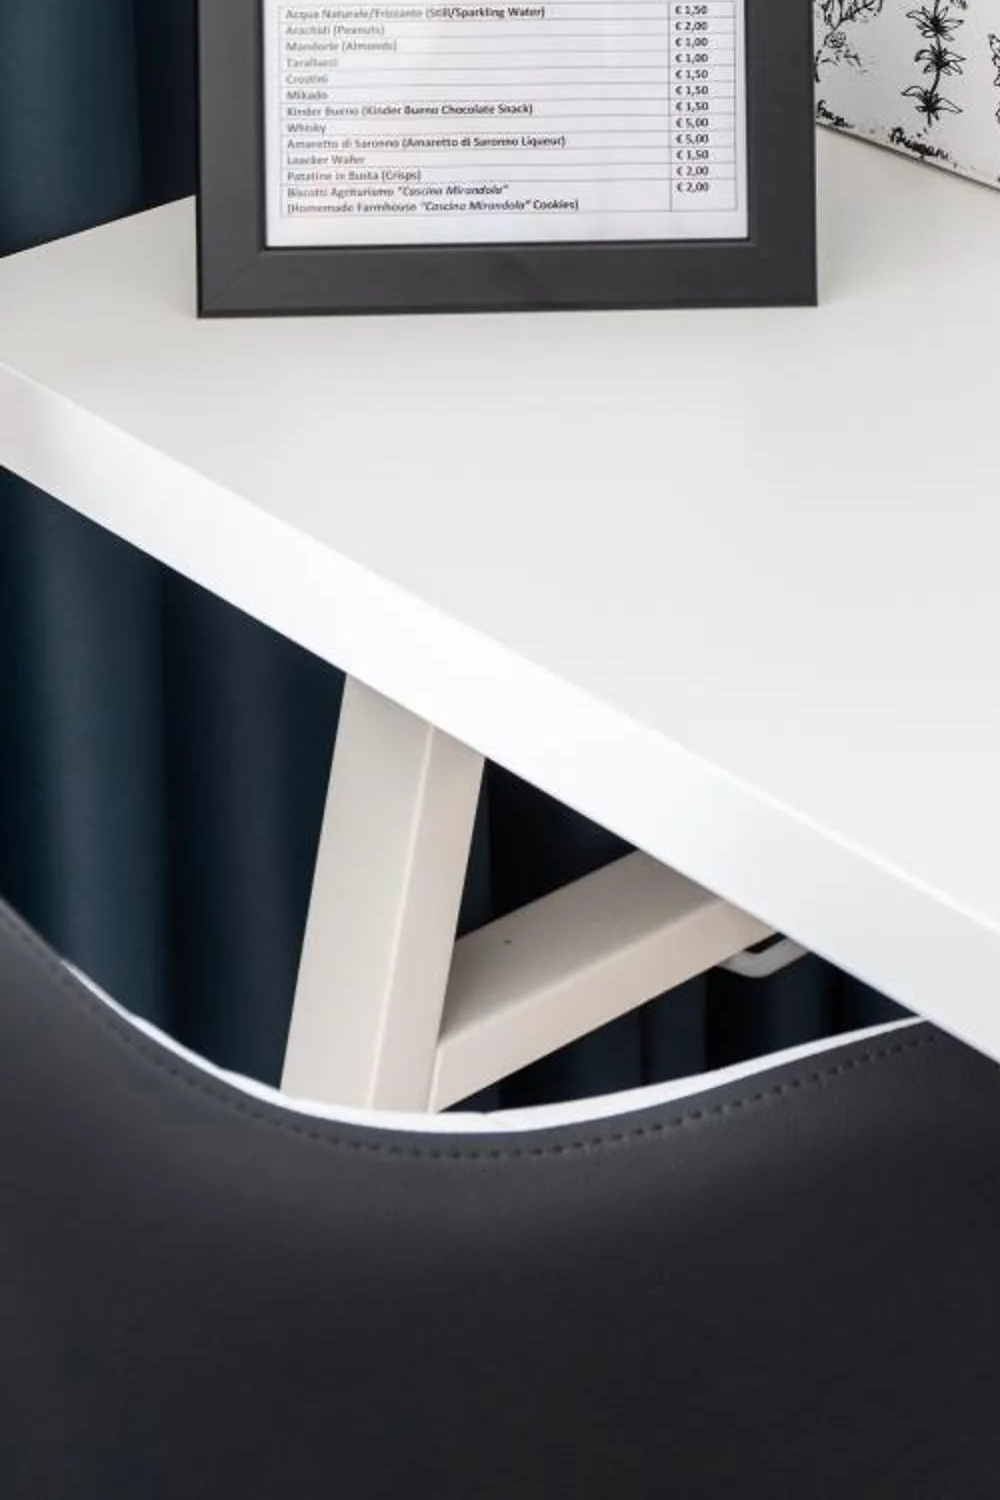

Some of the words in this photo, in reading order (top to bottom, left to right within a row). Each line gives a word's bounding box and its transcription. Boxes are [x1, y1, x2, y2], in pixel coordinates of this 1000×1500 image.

[508, 6, 546, 19] Water)
[685, 5, 709, 16] 1,50
[685, 21, 709, 32] 2,00
[685, 37, 709, 48] 1,00
[685, 53, 709, 65] 1,00
[685, 69, 709, 81] 1,50
[685, 85, 709, 97] 1,50
[361, 104, 402, 118] (Kinder
[403, 104, 439, 116] Bueno
[441, 103, 495, 115] Chocolate
[498, 102, 533, 116] Snack)
[685, 101, 709, 113] 1,50
[286, 122, 327, 135] Whisky
[685, 117, 709, 129] 5,00
[401, 137, 458, 150] (Amaretto
[460, 136, 471, 147] di
[473, 136, 519, 147] Saronno
[521, 134, 566, 149] Liqueur)
[685, 133, 709, 145] 5,00
[685, 149, 709, 161] 1,50
[347, 170, 379, 181] Busta
[381, 168, 421, 183] (Crisps)
[685, 165, 709, 177] 2,00
[685, 181, 709, 193] 2,00
[533, 196, 579, 212] Cookies)
